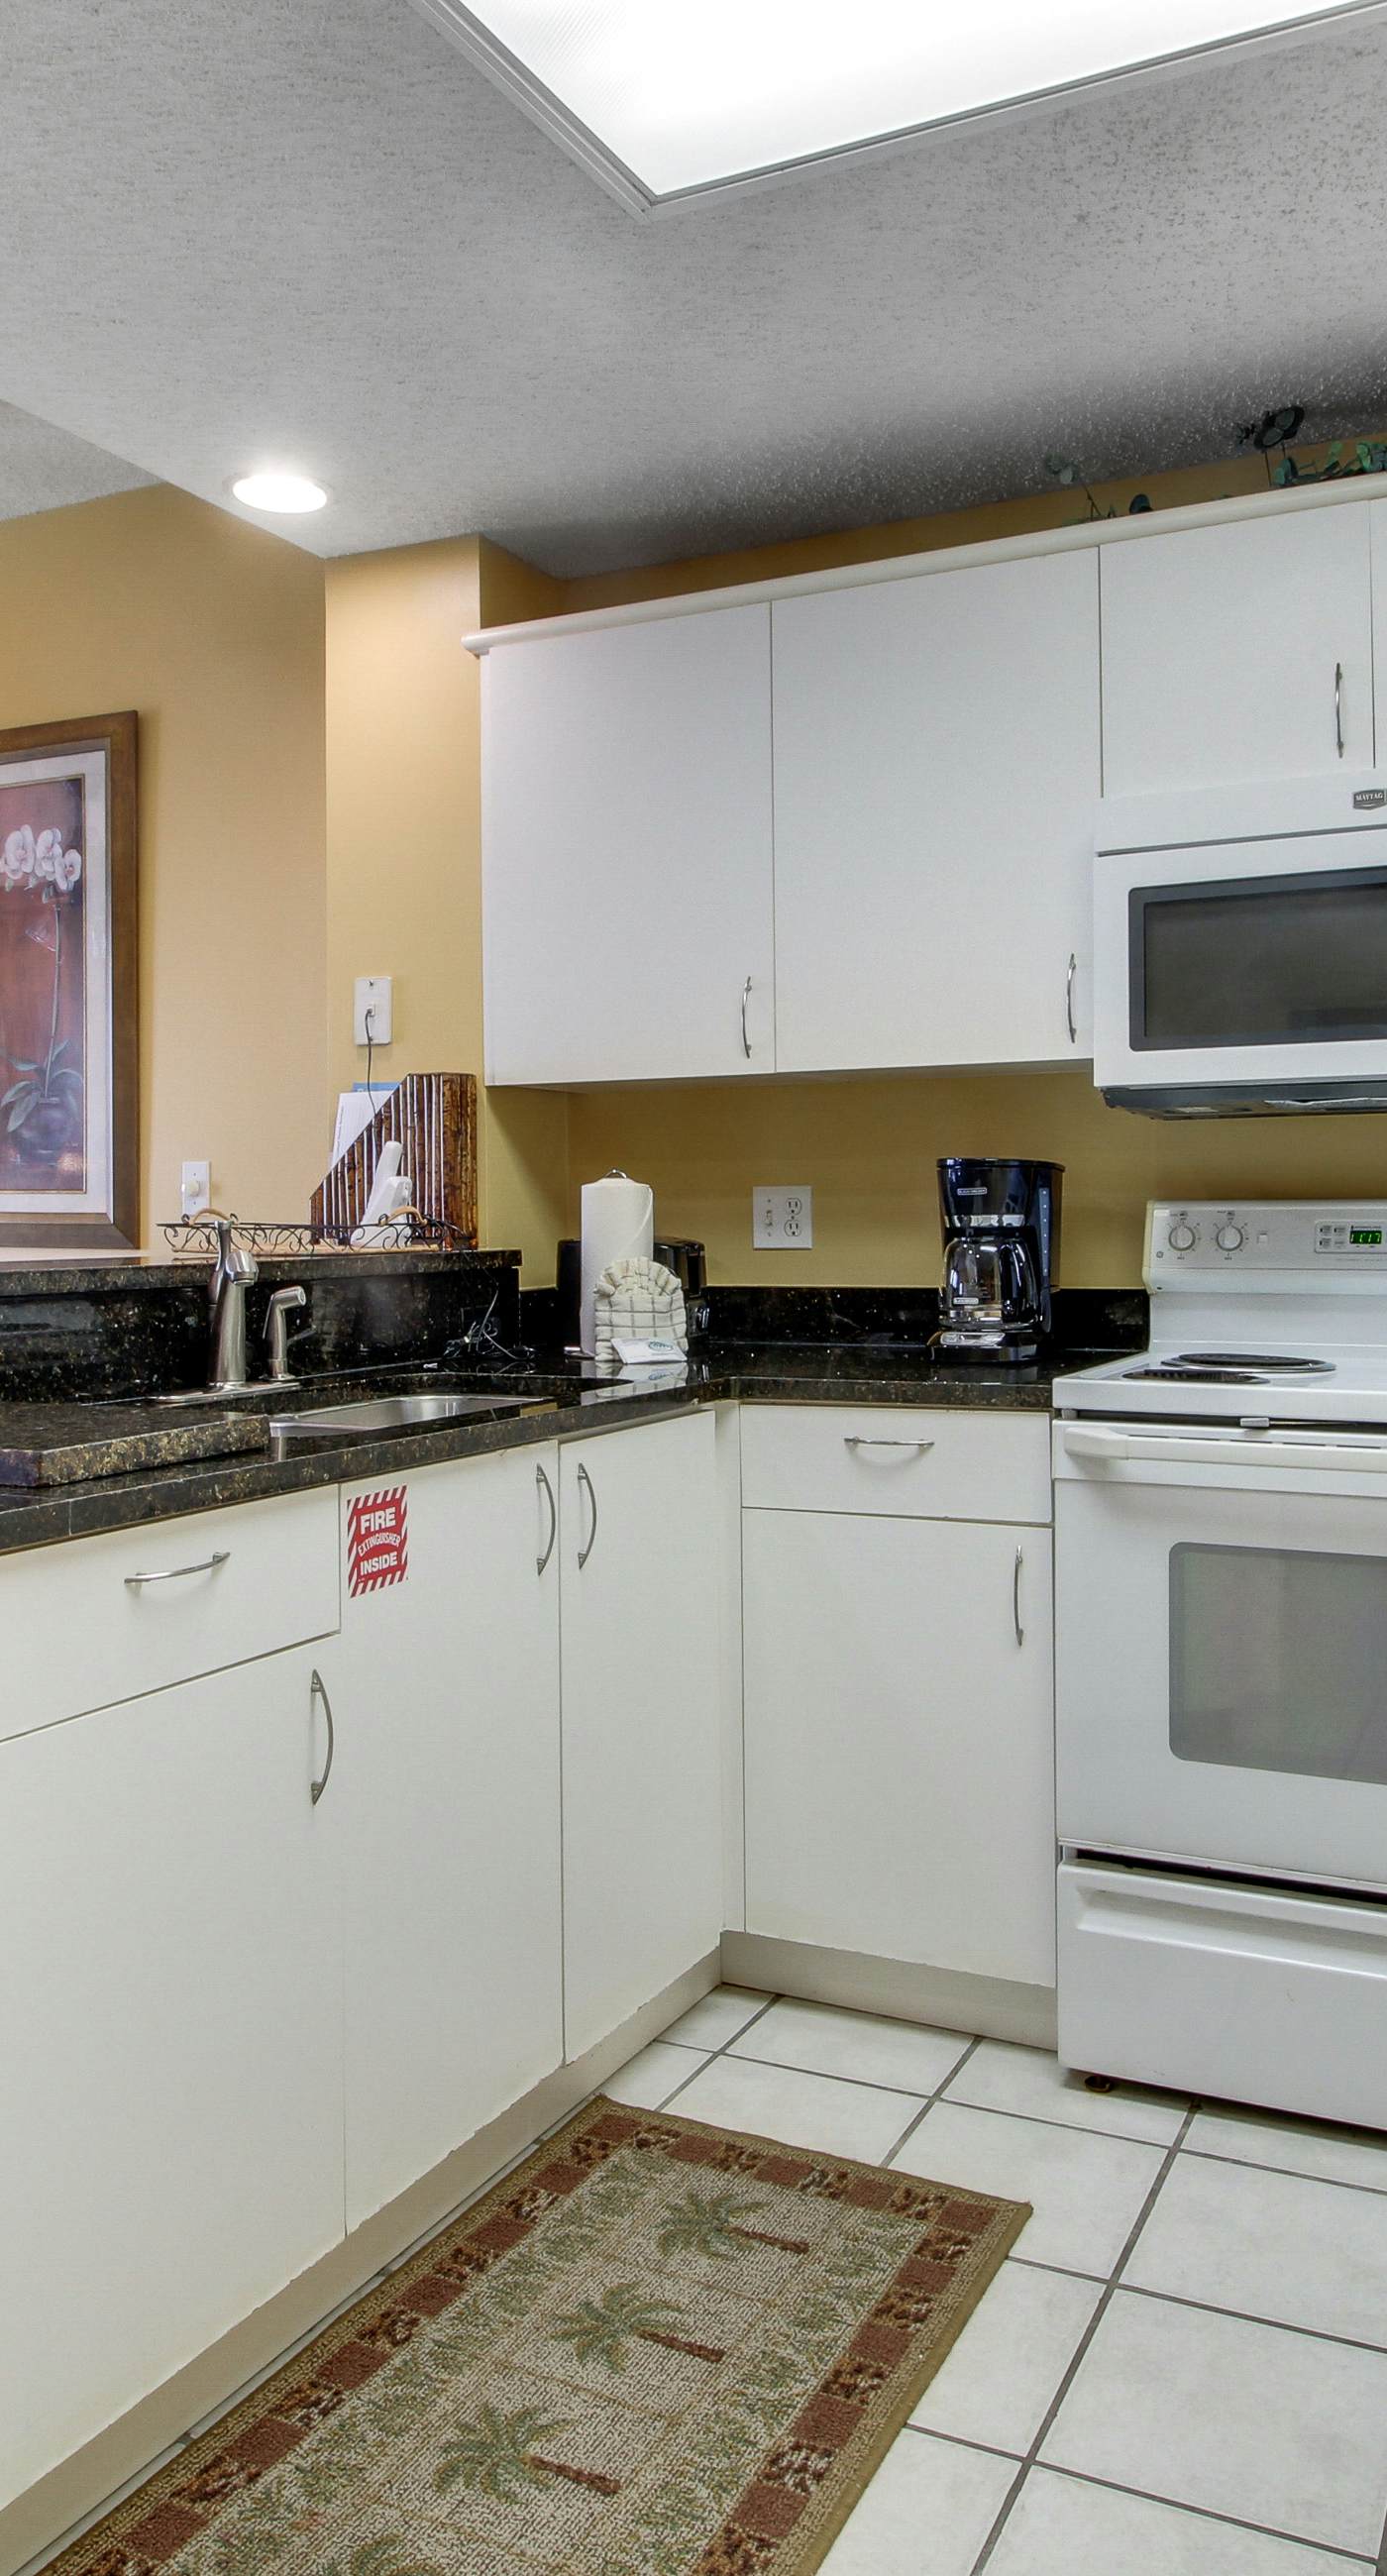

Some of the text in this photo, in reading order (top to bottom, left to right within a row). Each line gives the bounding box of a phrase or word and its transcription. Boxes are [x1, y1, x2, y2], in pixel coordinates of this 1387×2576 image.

[1355, 792, 1383, 801] MAYTAG
[361, 1507, 396, 1535] FIRE
[358, 1532, 400, 1556] EXTINGUISHER
[361, 1552, 397, 1575] INSIDE
